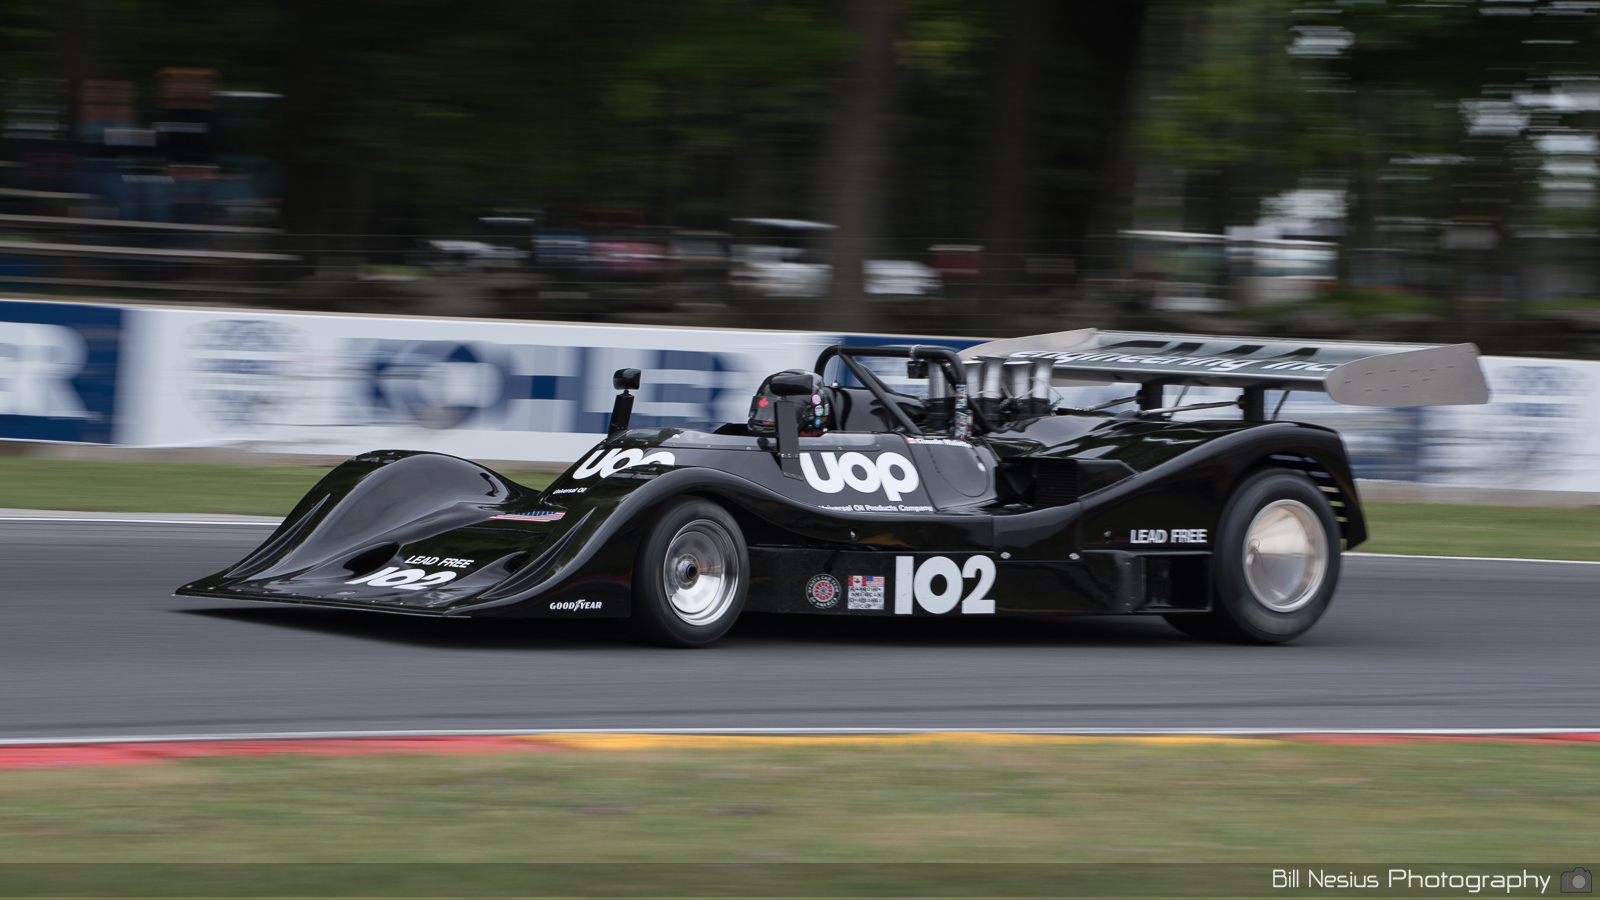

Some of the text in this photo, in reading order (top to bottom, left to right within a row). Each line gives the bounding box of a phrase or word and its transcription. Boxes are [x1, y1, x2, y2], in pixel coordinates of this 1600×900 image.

[1130, 529, 1208, 544] LEAD FREE
[404, 555, 475, 568] LEAD FREE
[344, 566, 457, 590] 102
[894, 555, 996, 615] 102
[550, 599, 603, 611] GOODYEAR
